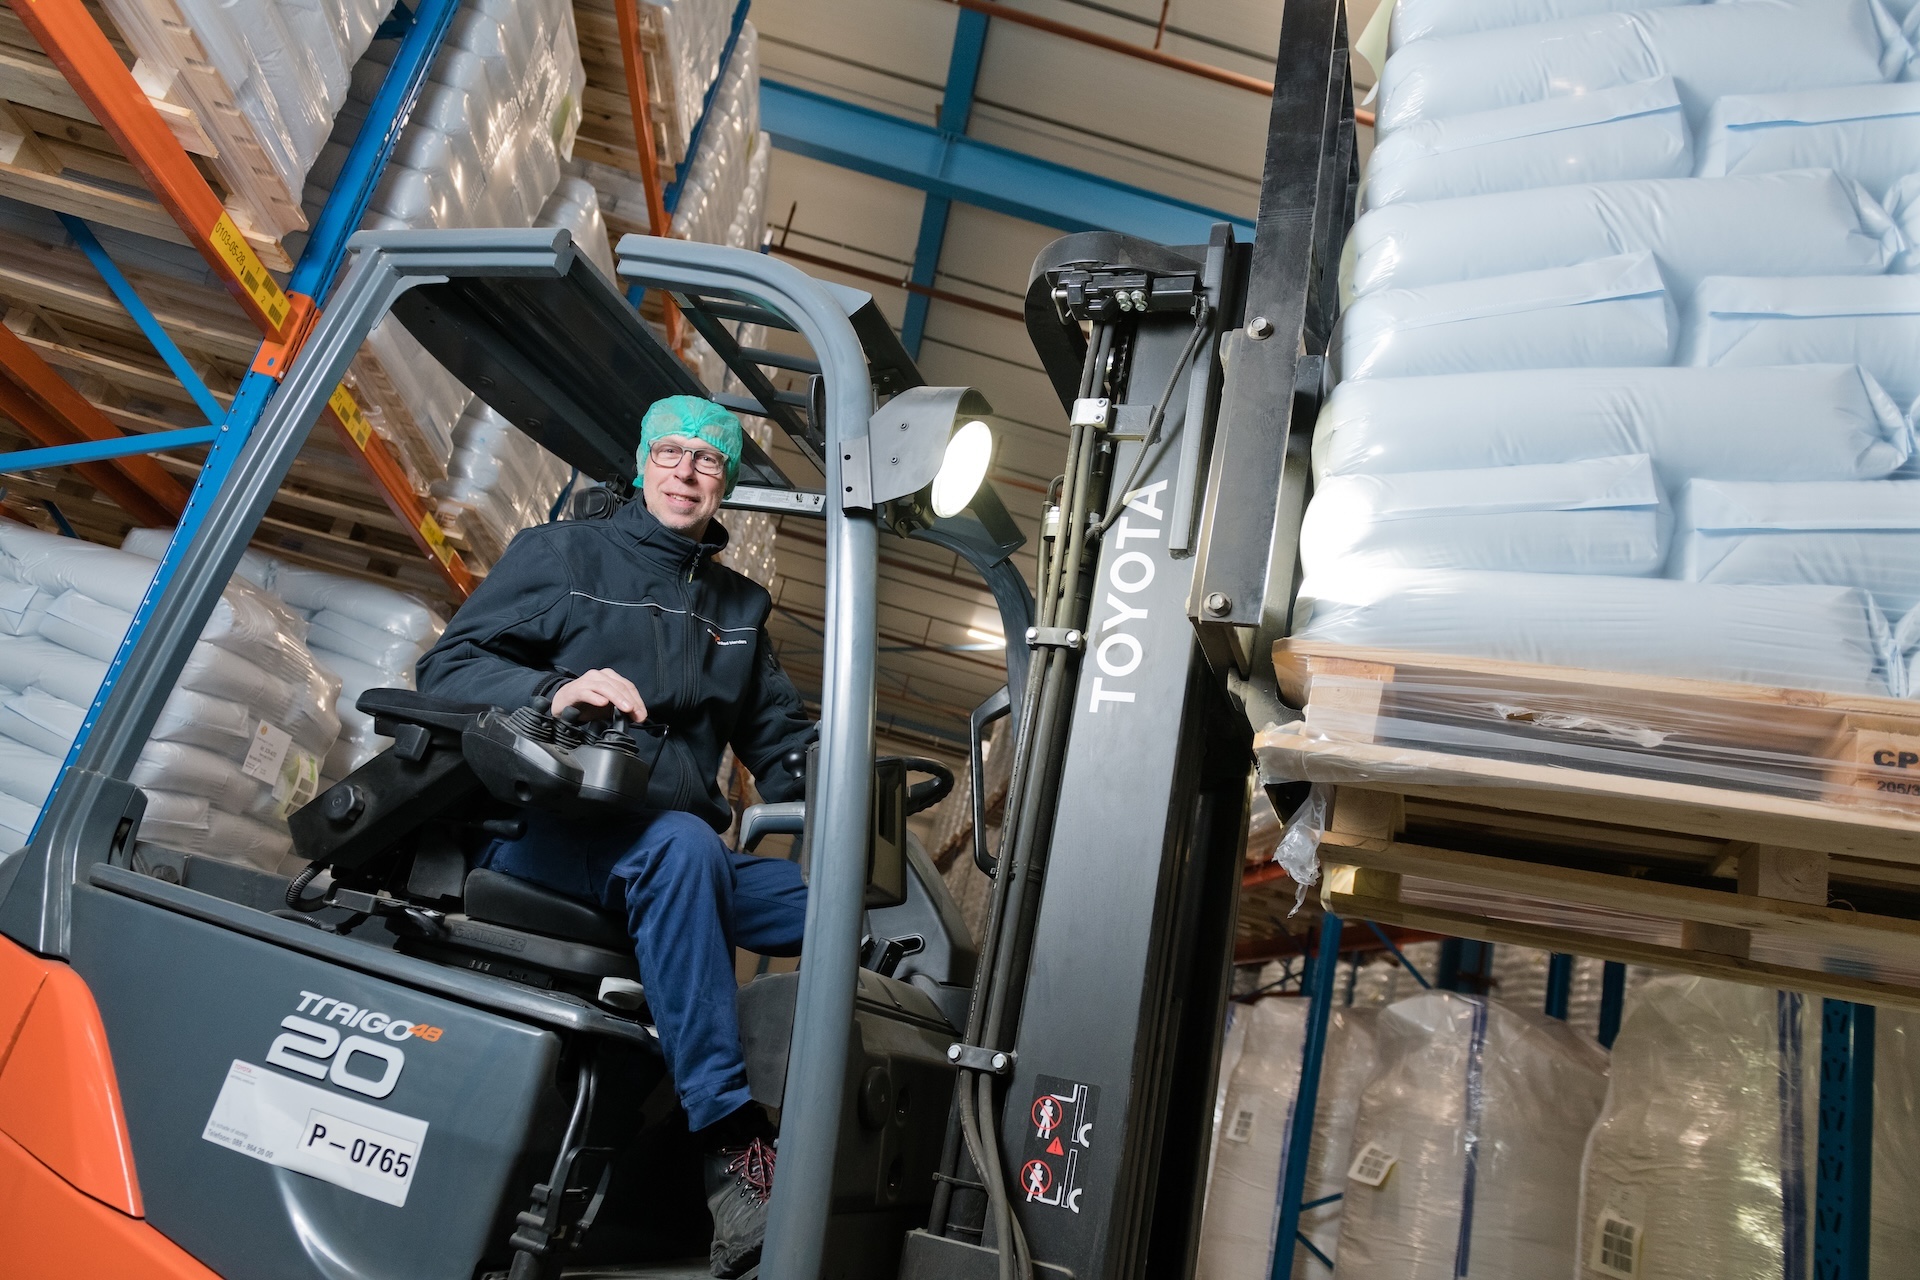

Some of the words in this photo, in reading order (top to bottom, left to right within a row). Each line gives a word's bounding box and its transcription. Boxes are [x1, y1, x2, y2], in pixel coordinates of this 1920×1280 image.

[215, 222, 246, 265] 0103-05-28
[1089, 479, 1168, 713] TOYOTA
[265, 1015, 405, 1100] 20
